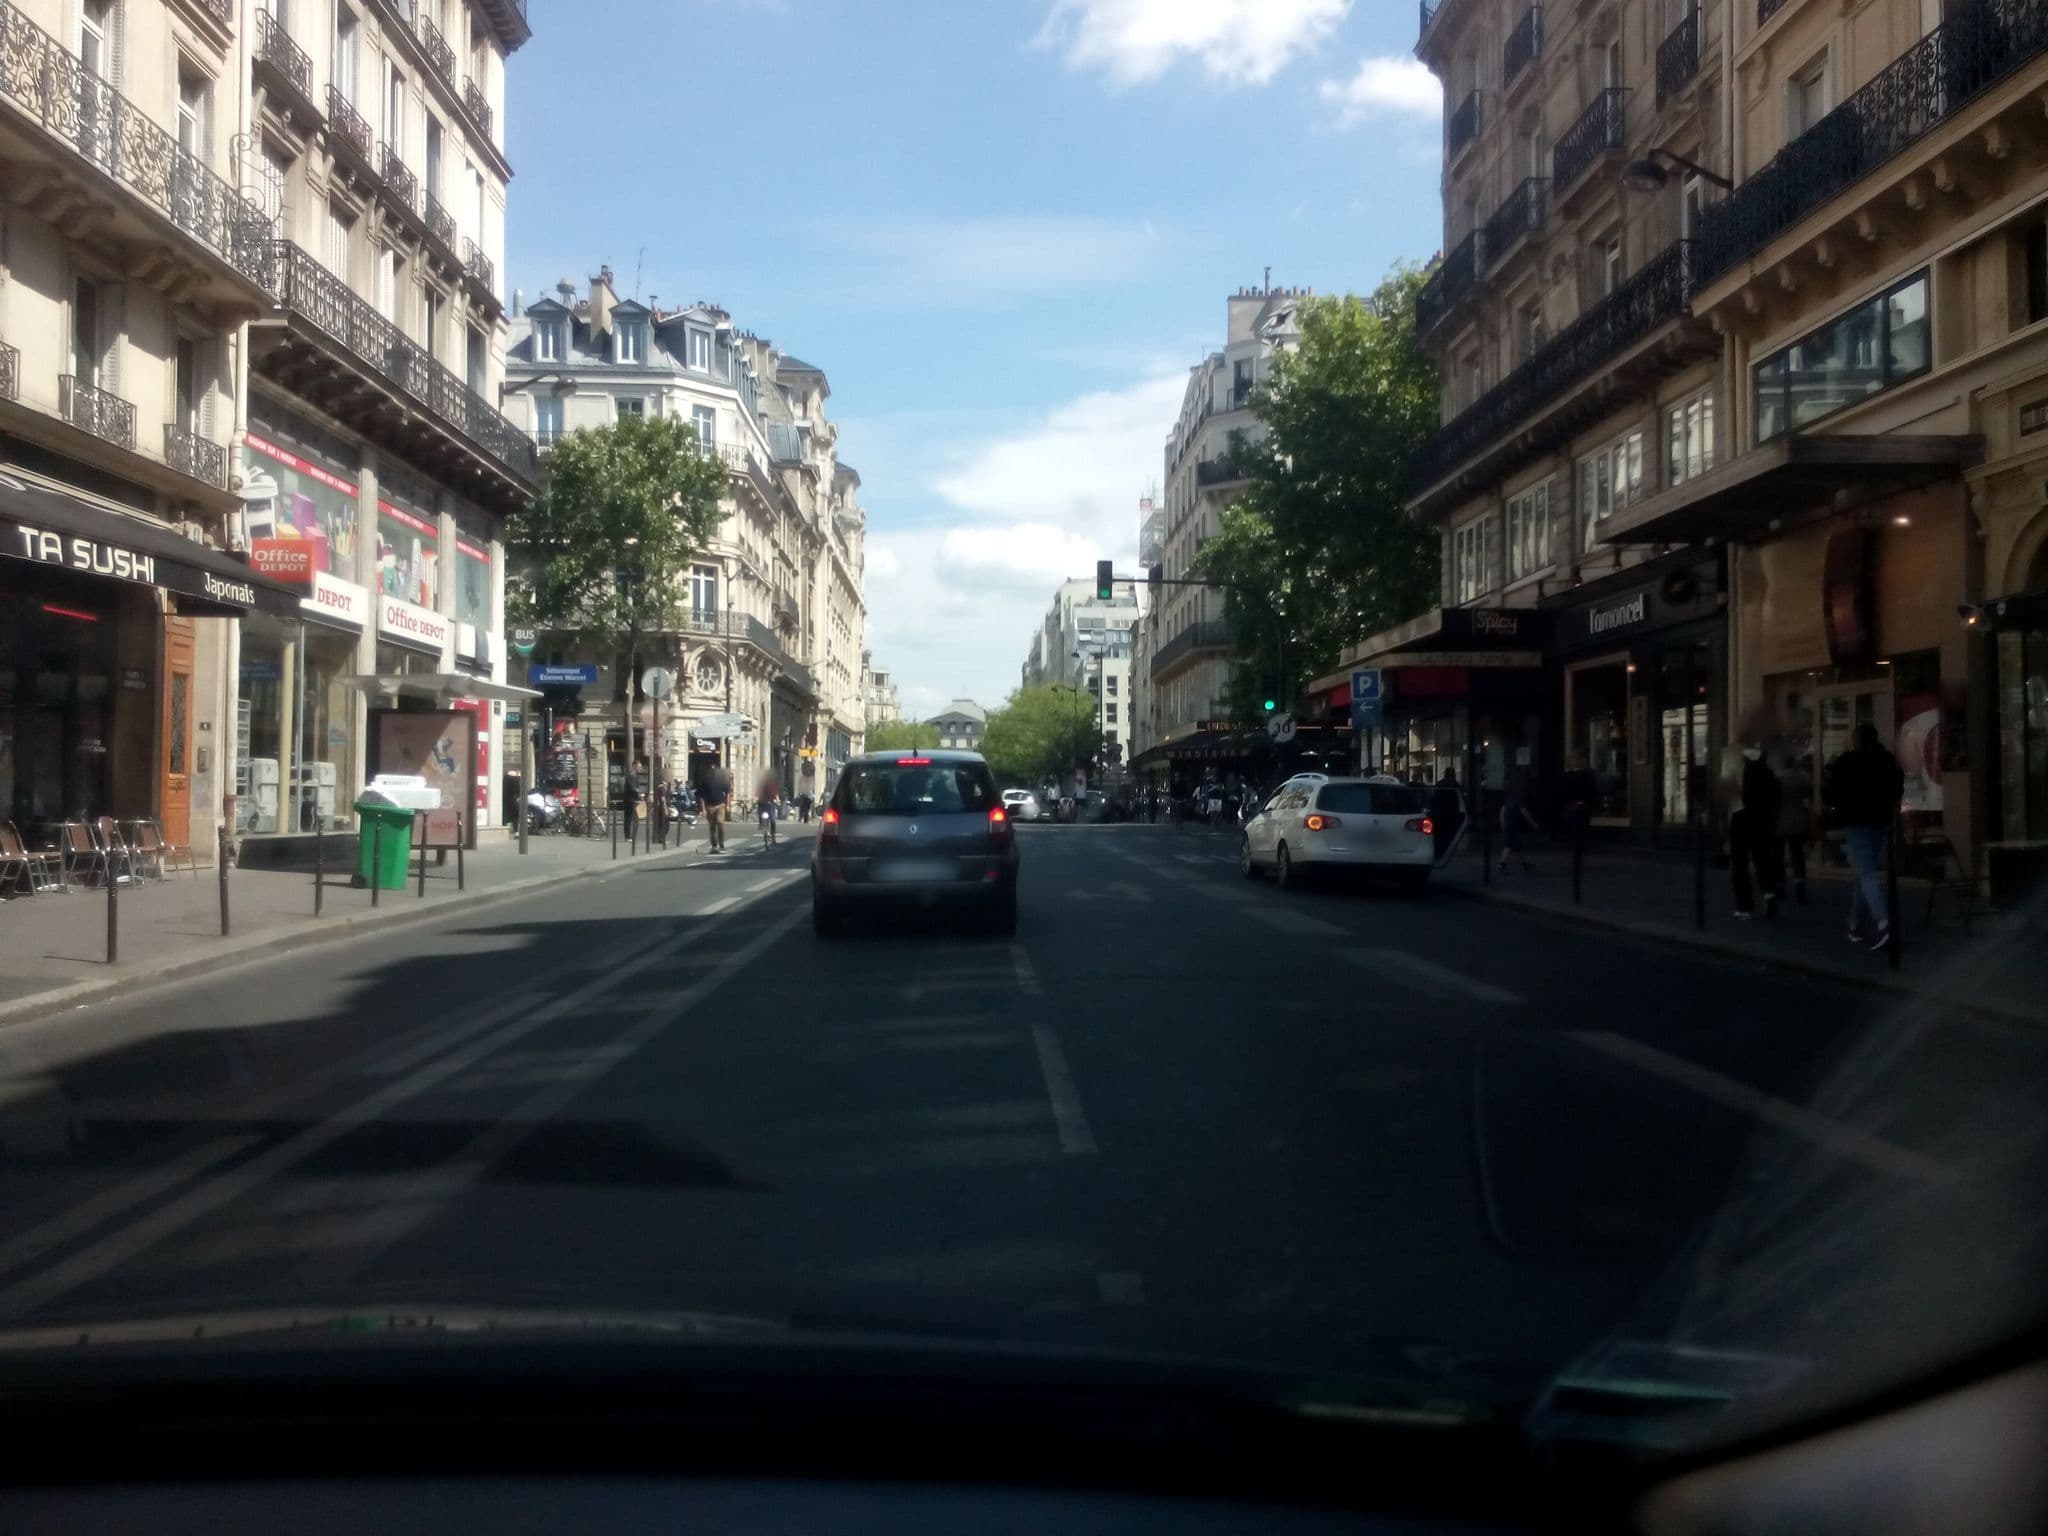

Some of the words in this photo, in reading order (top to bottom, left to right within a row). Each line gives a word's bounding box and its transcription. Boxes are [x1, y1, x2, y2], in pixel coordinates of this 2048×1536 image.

[18, 526, 63, 562] TA
[73, 539, 154, 584] SUSHI
[254, 550, 308, 562] Office
[260, 563, 306, 572] DEPOT
[204, 572, 255, 604] Japonais
[317, 587, 352, 612] DEPOT
[387, 606, 418, 632] Office
[420, 622, 445, 640] DEPOT
[515, 629, 535, 639] BUS
[1359, 676, 1371, 694] P
[1275, 722, 1291, 734] 30
